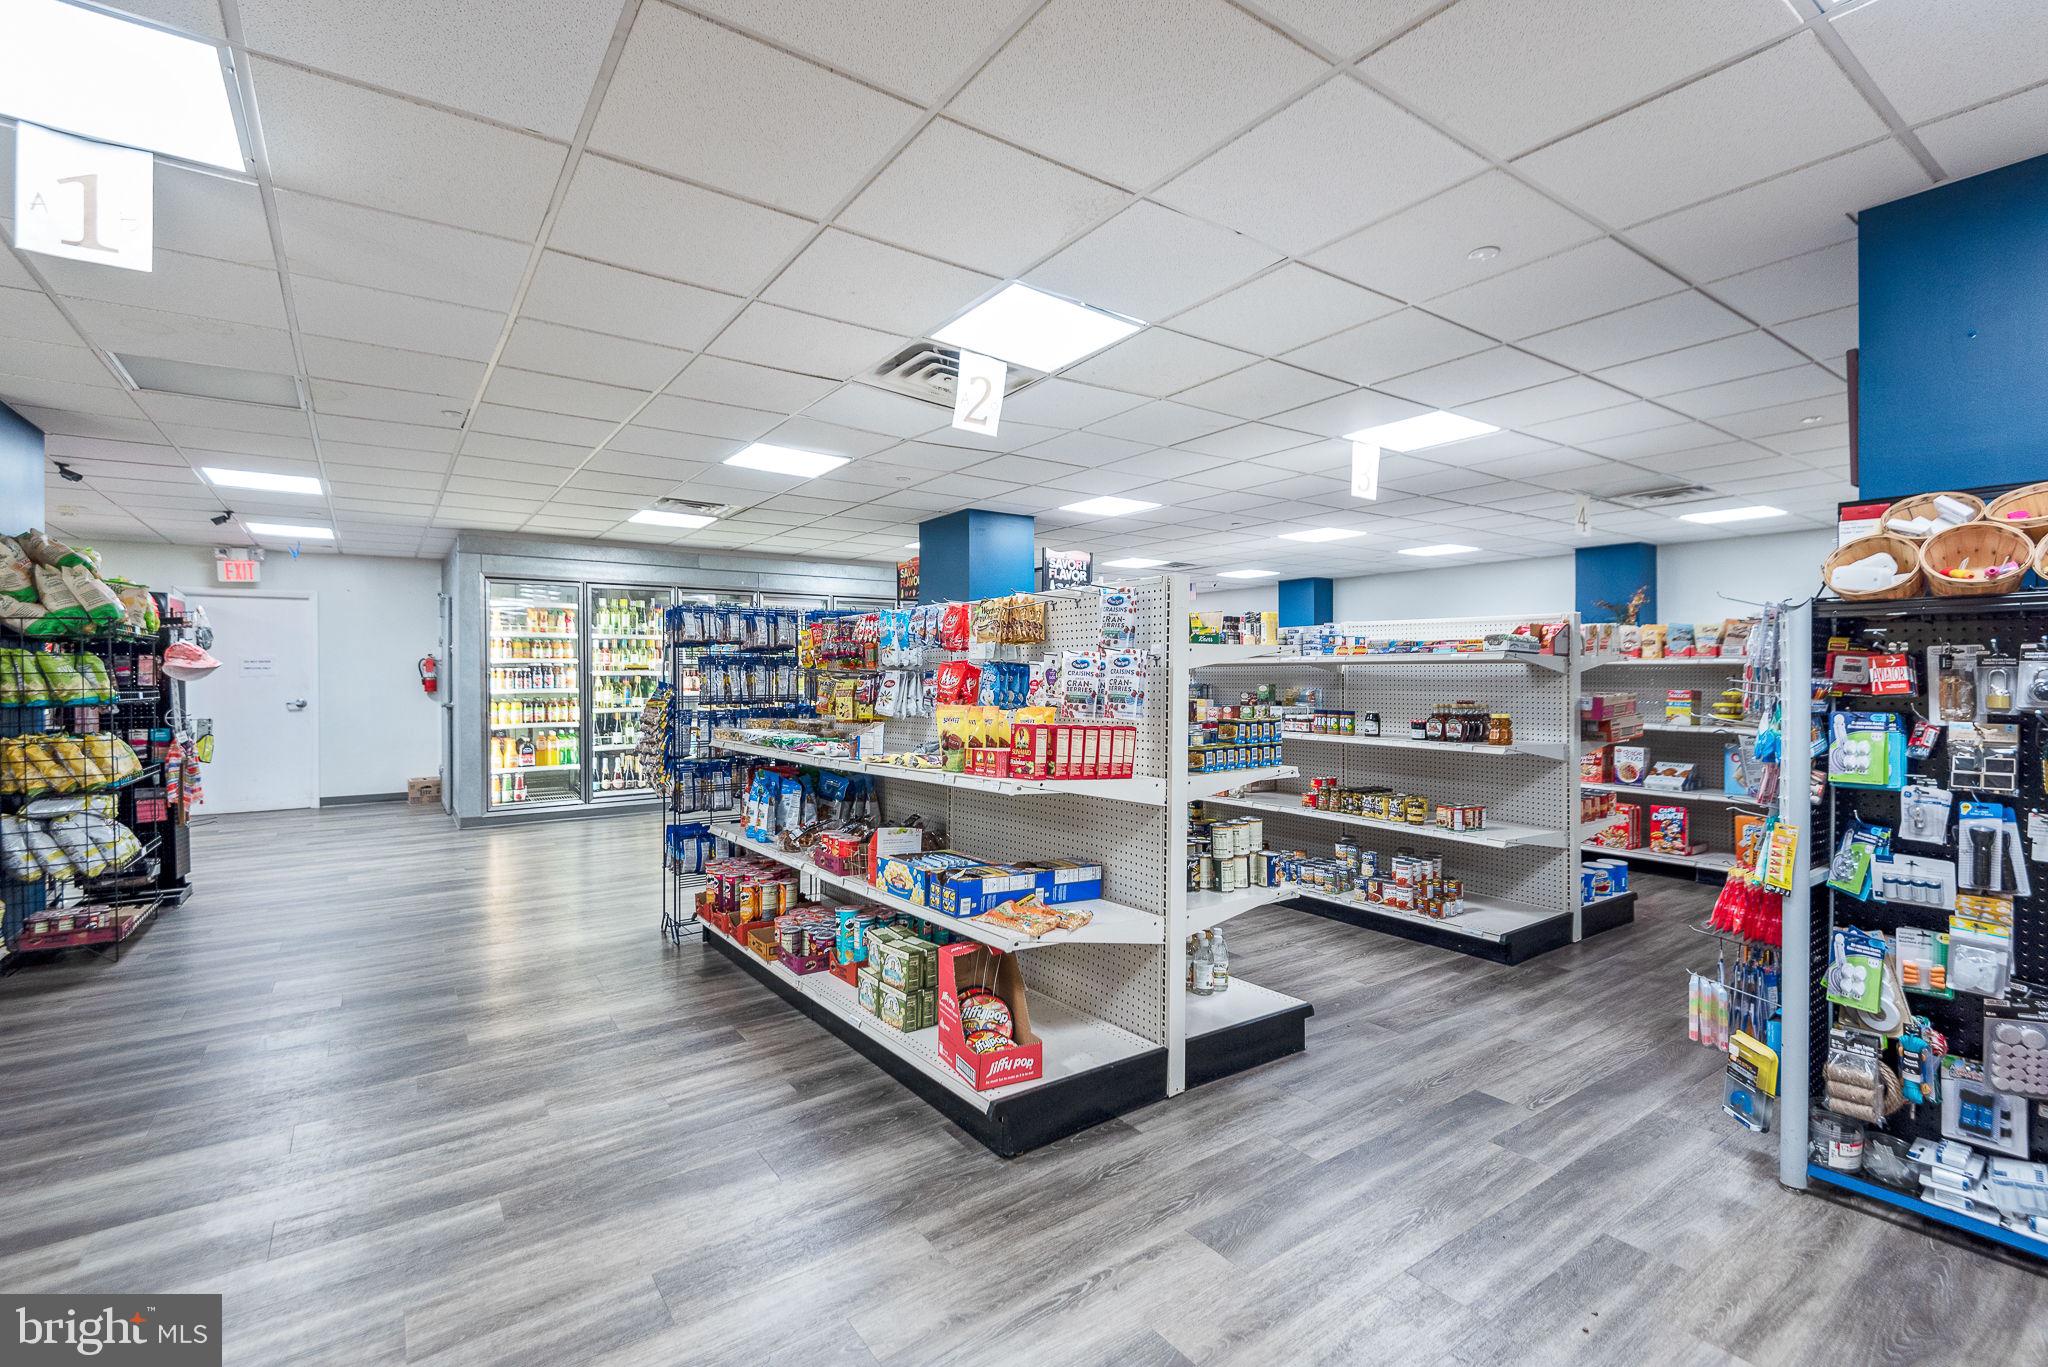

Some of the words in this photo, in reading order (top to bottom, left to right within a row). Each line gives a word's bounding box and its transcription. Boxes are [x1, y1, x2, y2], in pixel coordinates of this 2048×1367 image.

[57, 174, 119, 253] 1
[964, 376, 992, 426] 2
[1577, 506, 1588, 532] 4
[223, 561, 255, 581] EXIT
[1049, 558, 1083, 570] SAVOR
[1049, 569, 1087, 581] FLAVOR
[985, 1056, 1013, 1078] Jiffy
[1013, 1057, 1034, 1070] pop
